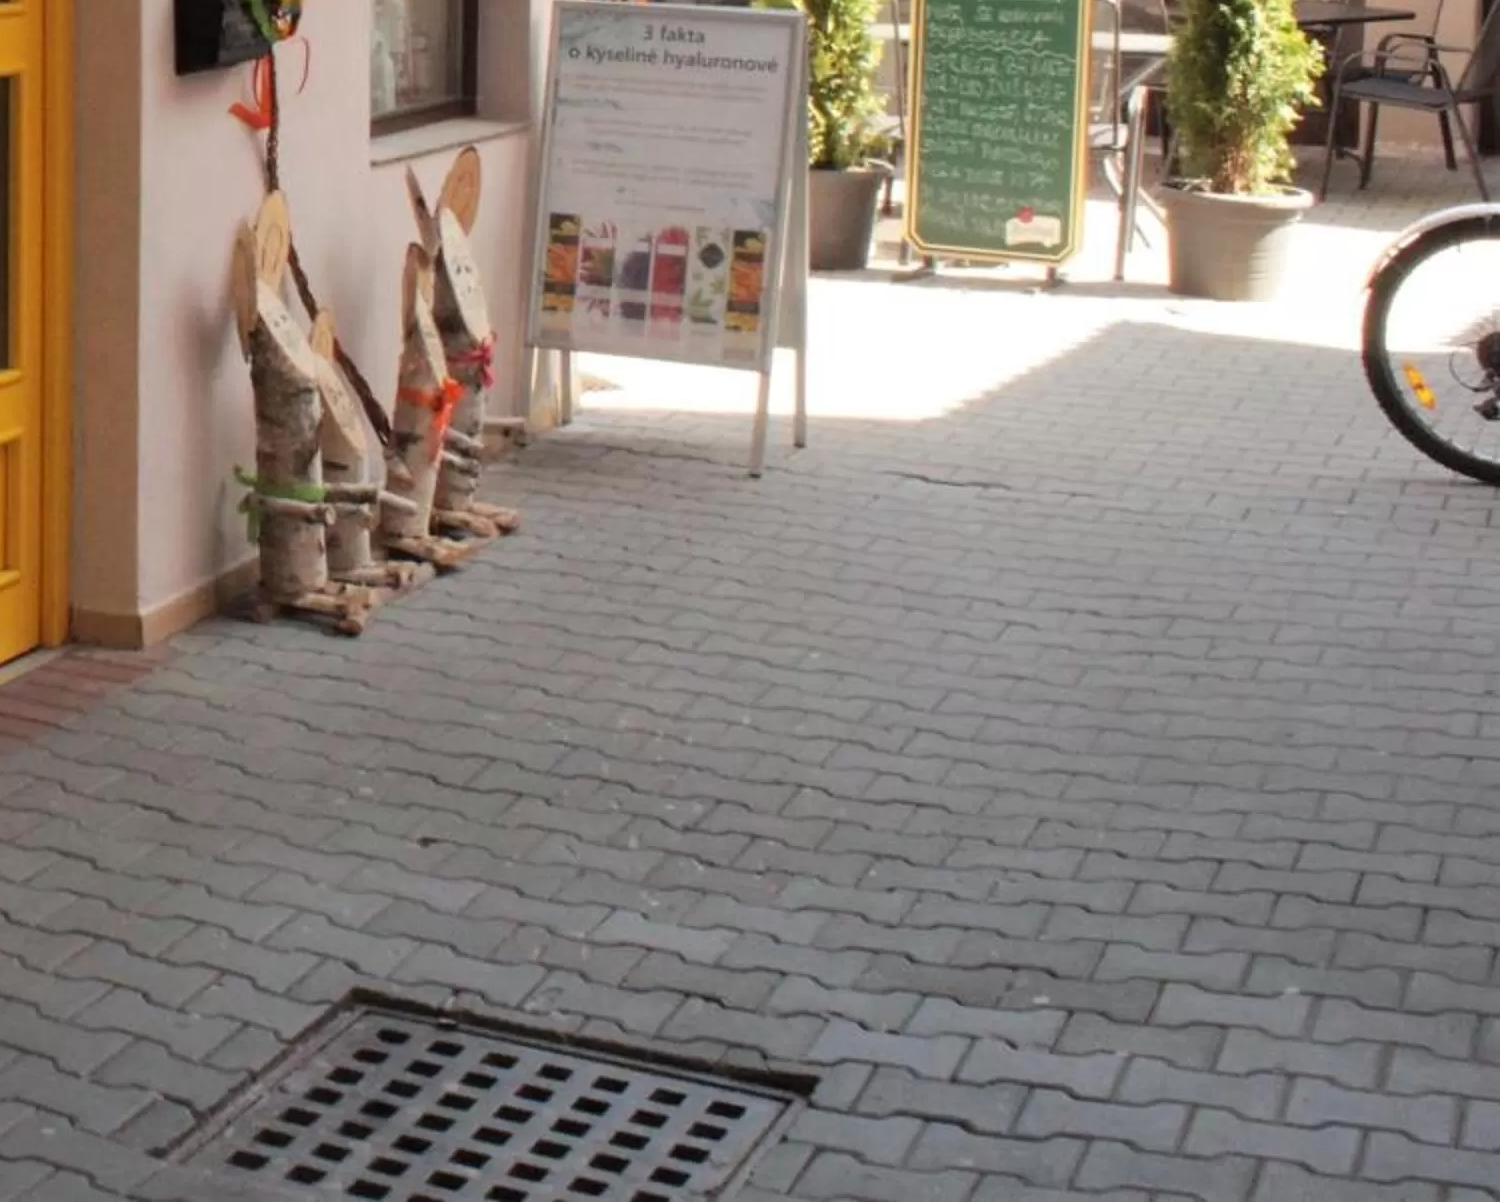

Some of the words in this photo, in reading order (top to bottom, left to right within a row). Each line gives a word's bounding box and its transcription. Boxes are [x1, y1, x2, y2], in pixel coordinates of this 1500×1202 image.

[643, 24, 654, 42] 3
[659, 25, 707, 45] fakta
[567, 46, 582, 60] o
